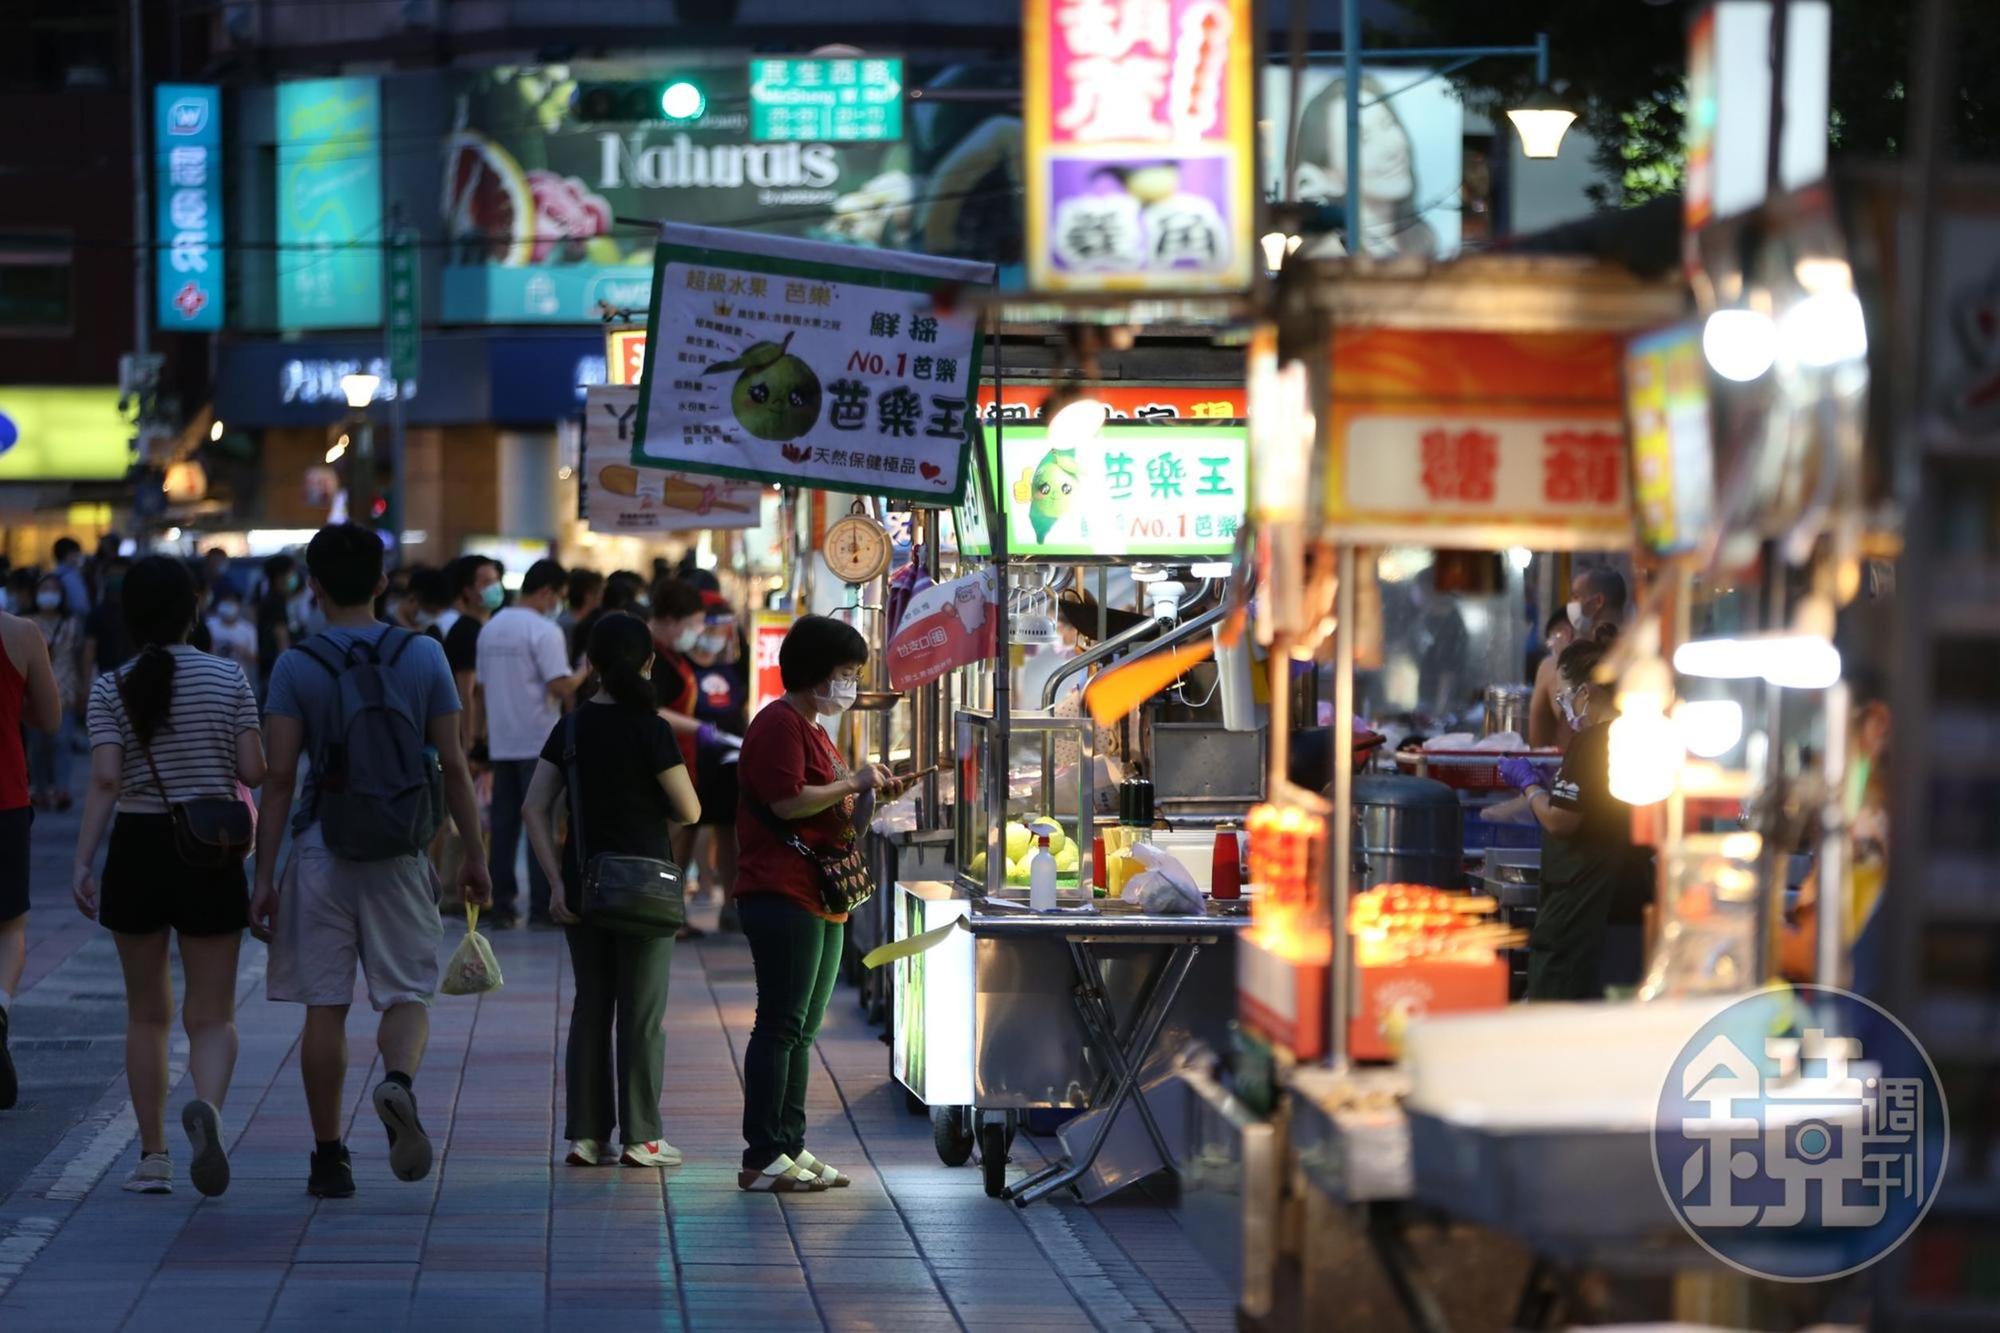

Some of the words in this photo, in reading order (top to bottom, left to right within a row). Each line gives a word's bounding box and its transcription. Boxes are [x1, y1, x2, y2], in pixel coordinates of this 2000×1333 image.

[598, 132, 839, 189] Naturals
[685, 269, 768, 299] 超級水果
[785, 280, 832, 307] 芭樂
[870, 311, 939, 343] 鮮採
[913, 355, 957, 383] 芭樂
[827, 378, 968, 442] 芭樂王
[814, 447, 917, 475] 天然保健極品
[1105, 451, 1235, 500] 芭樂王
